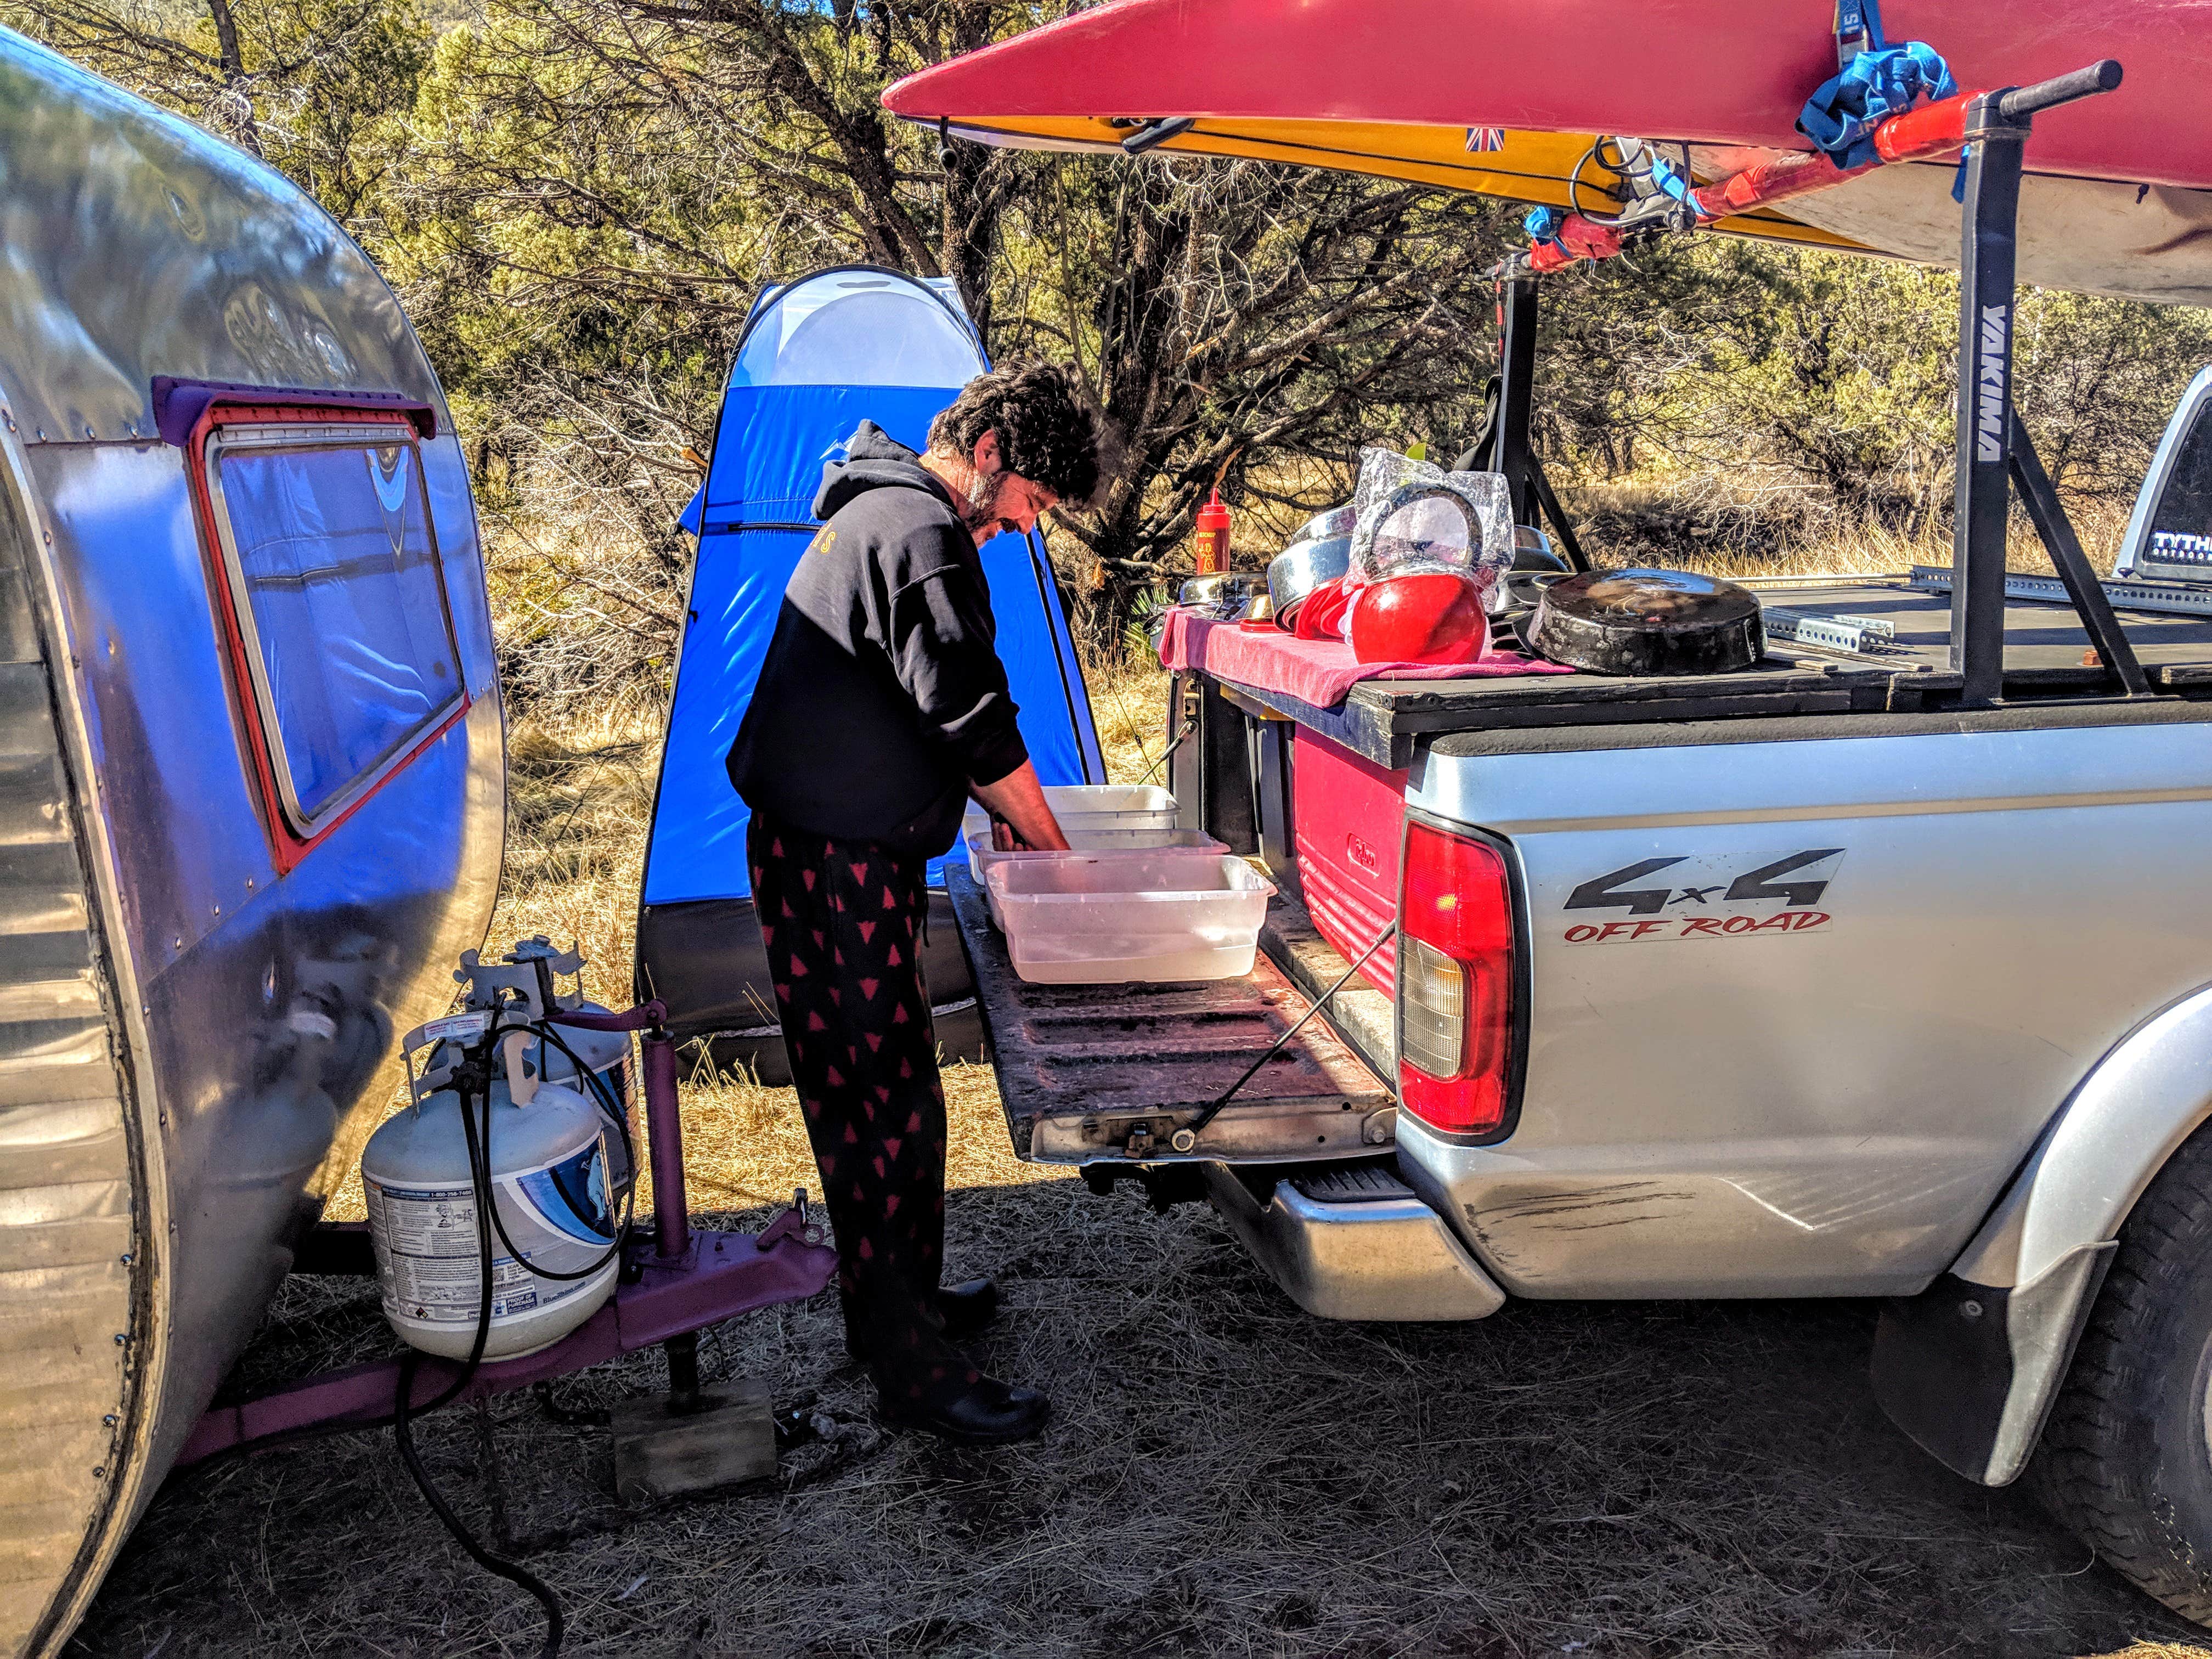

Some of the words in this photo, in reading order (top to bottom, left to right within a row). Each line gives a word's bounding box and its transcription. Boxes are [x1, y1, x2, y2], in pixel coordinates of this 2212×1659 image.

[1978, 305, 2005, 461] YAKIMA
[1564, 920, 1673, 943] OFF
[1680, 912, 1831, 936] ROAD
[507, 1295, 524, 1304] PROOF
